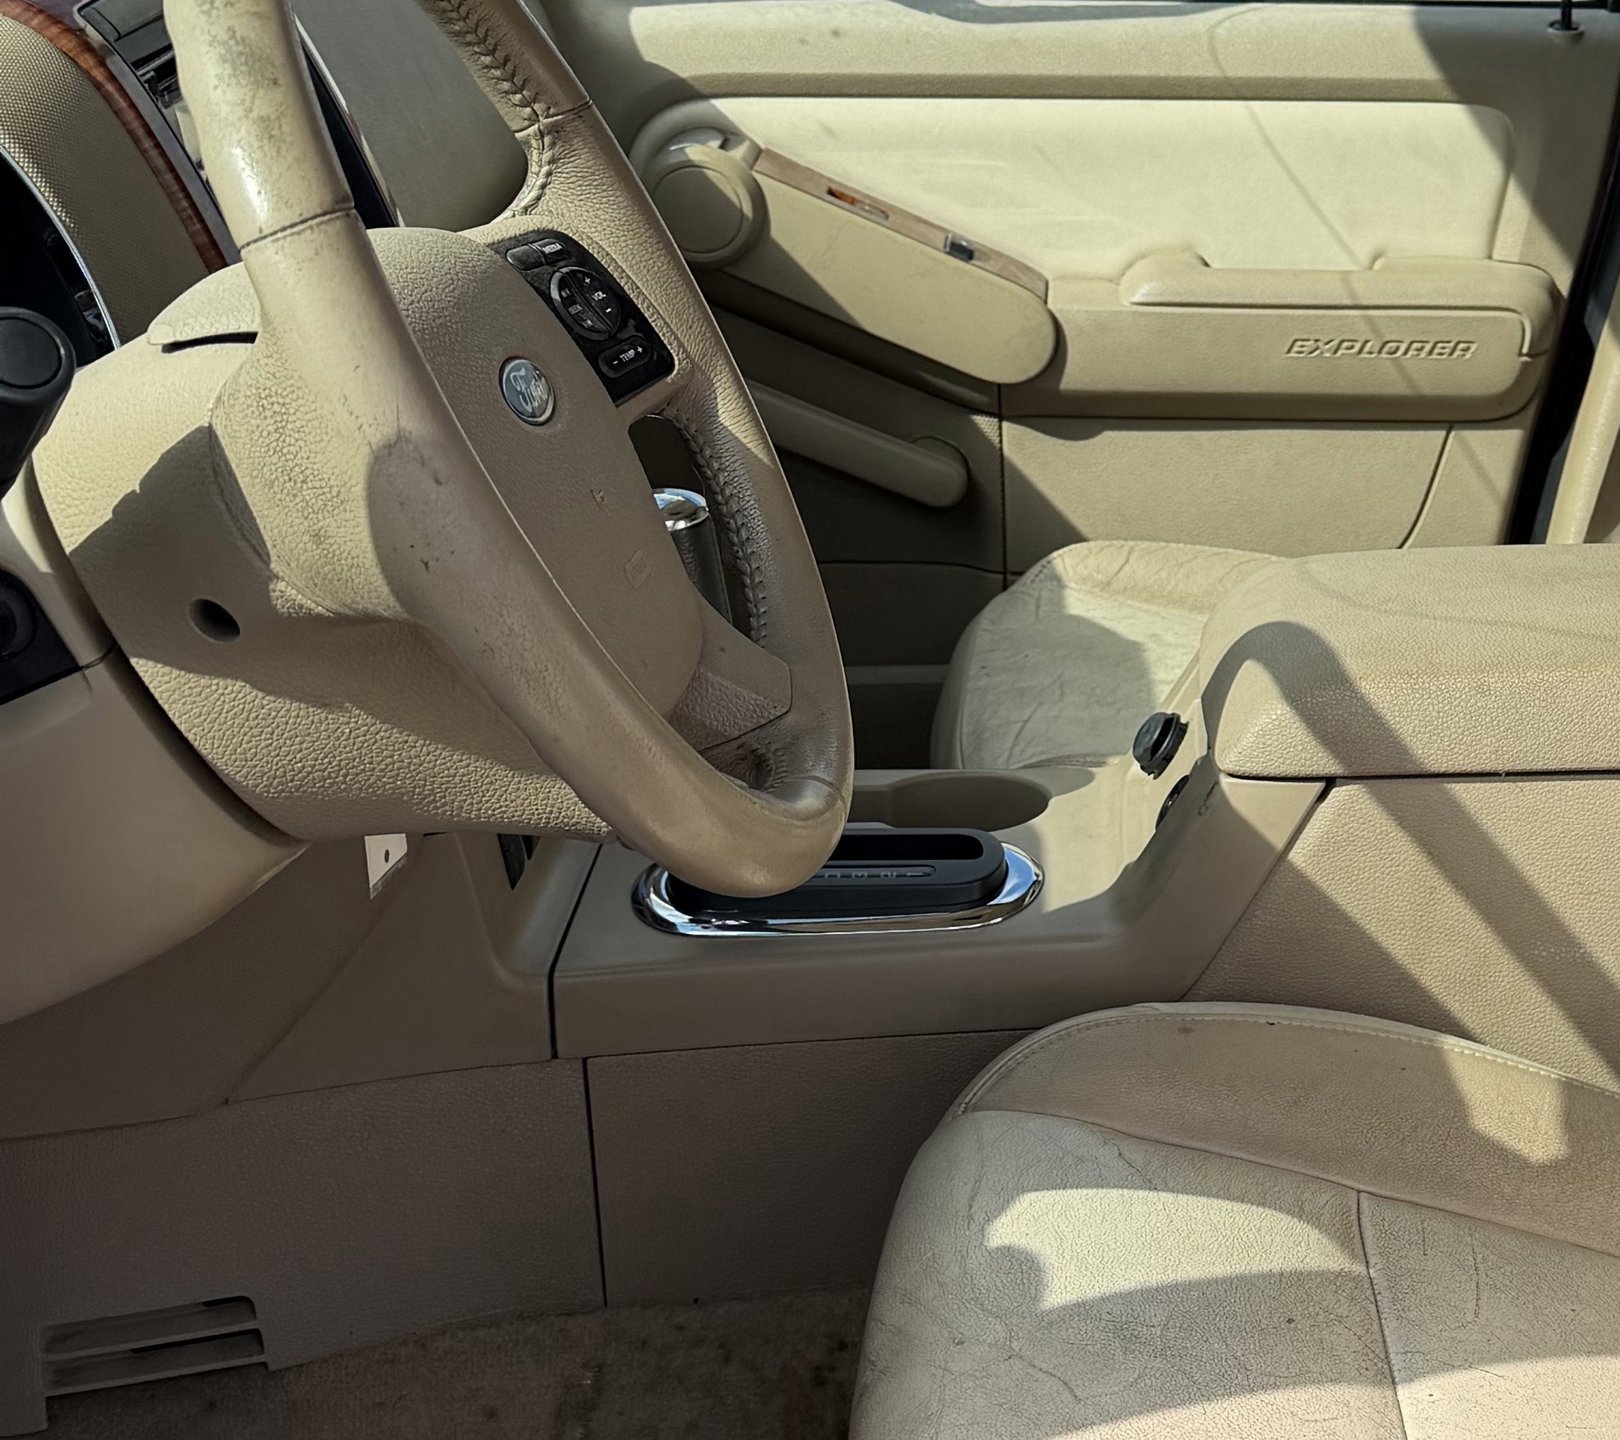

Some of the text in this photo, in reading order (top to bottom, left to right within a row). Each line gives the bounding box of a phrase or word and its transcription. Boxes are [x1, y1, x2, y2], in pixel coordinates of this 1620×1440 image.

[620, 349, 636, 362] TEMP
[1285, 338, 1478, 359] EXPLORER
[510, 367, 549, 412] Ford
